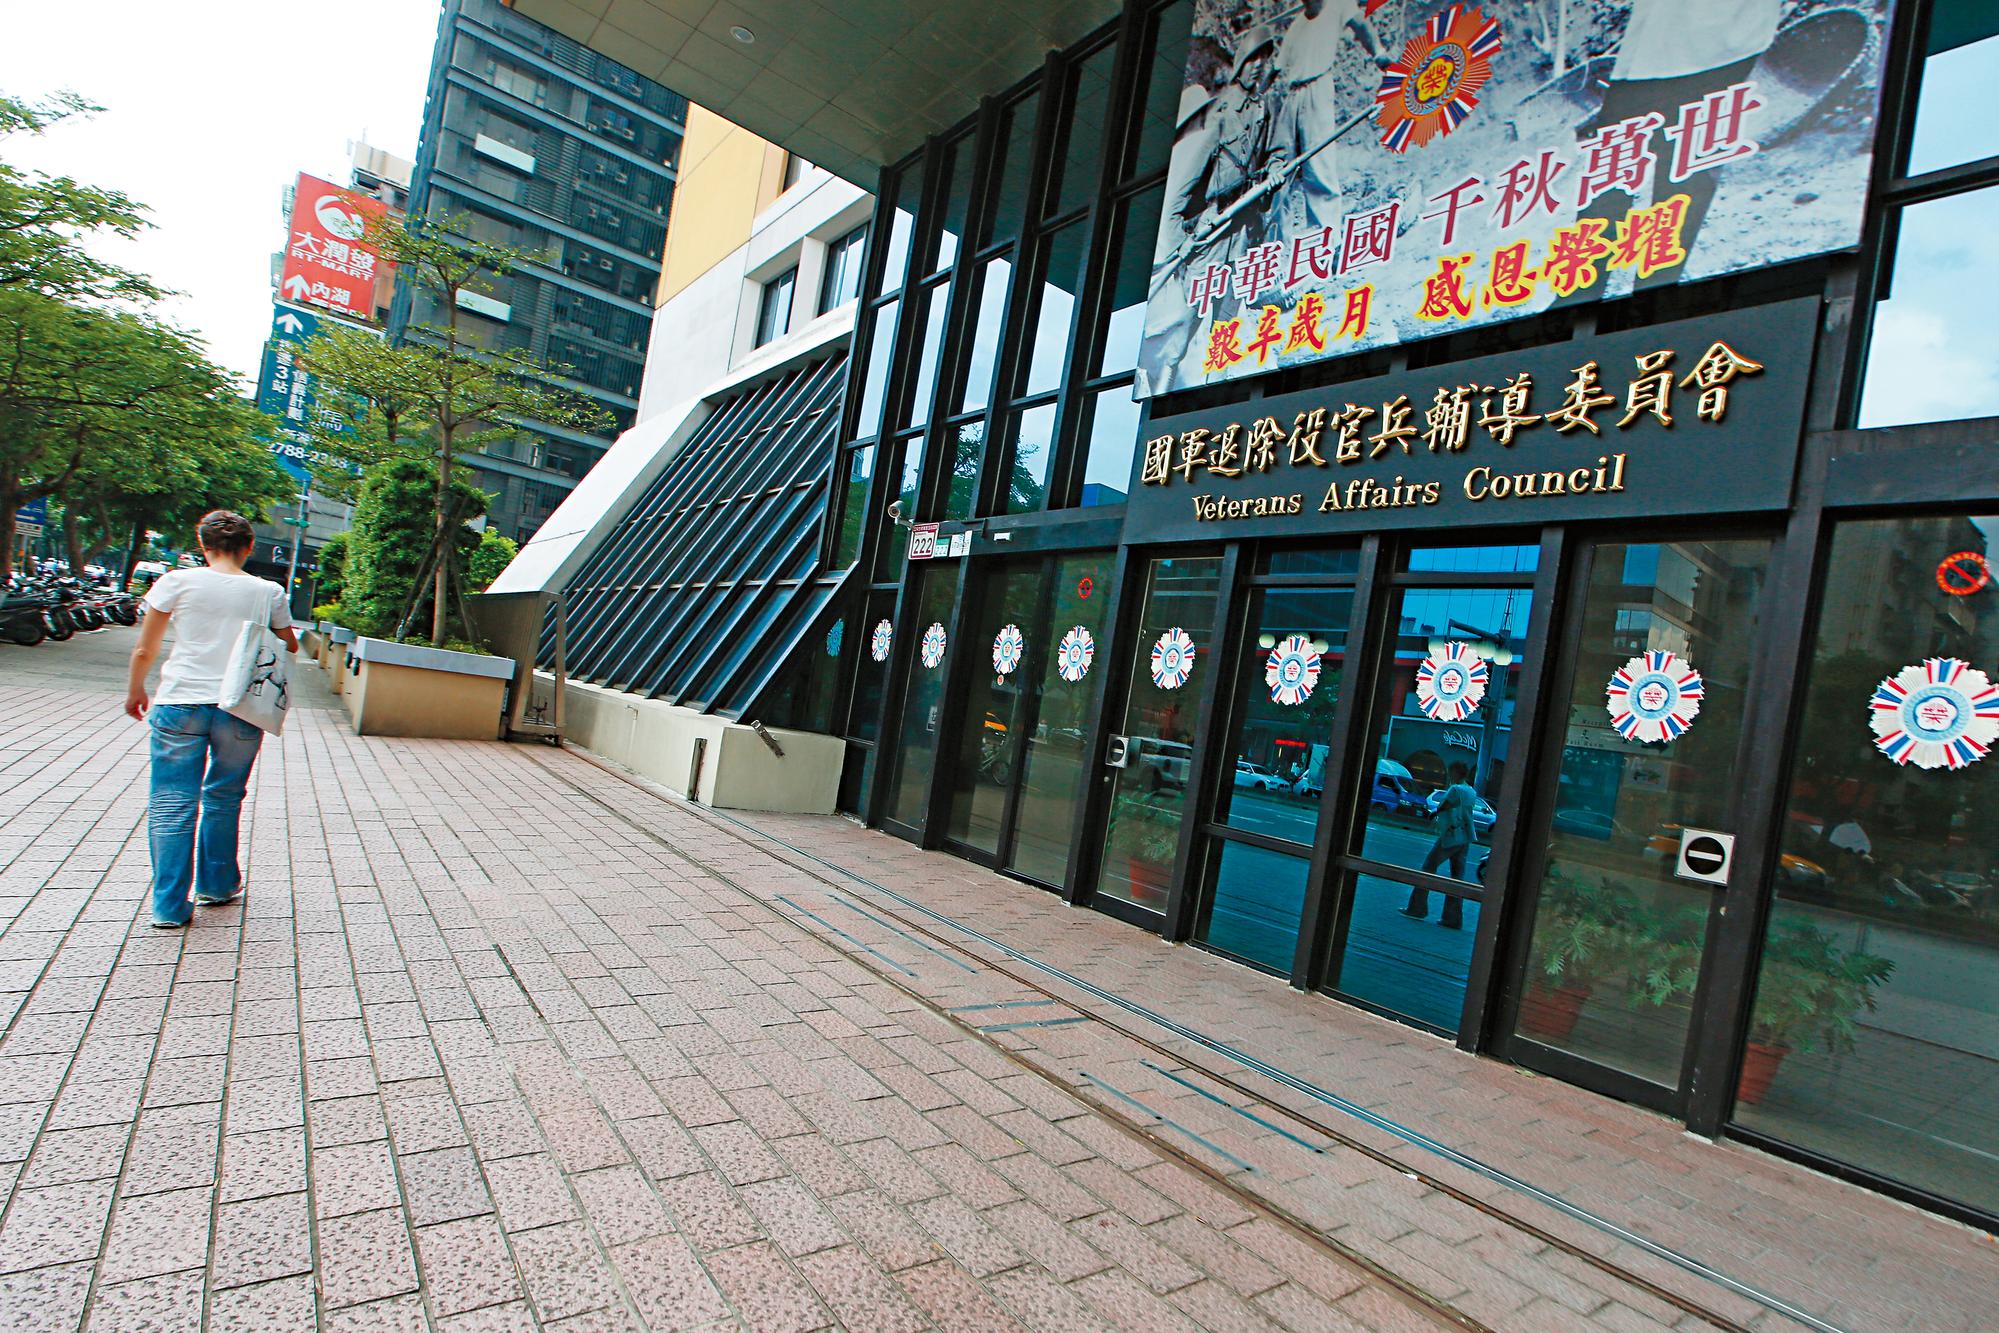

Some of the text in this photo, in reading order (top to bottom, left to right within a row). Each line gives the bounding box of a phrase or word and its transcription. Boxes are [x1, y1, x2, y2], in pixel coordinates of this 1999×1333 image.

[1188, 86, 1763, 316] 中華民國 千秋萬世
[291, 249, 374, 281] RT-MART
[292, 231, 375, 272] 大潤發
[1205, 199, 1684, 371] 艱辛歲月 感恩榮耀
[1141, 340, 1764, 485] 國軍退除役官兵輔導委員會
[1192, 453, 1627, 521] Veterans Affairs Council
[913, 537, 932, 554] 222
